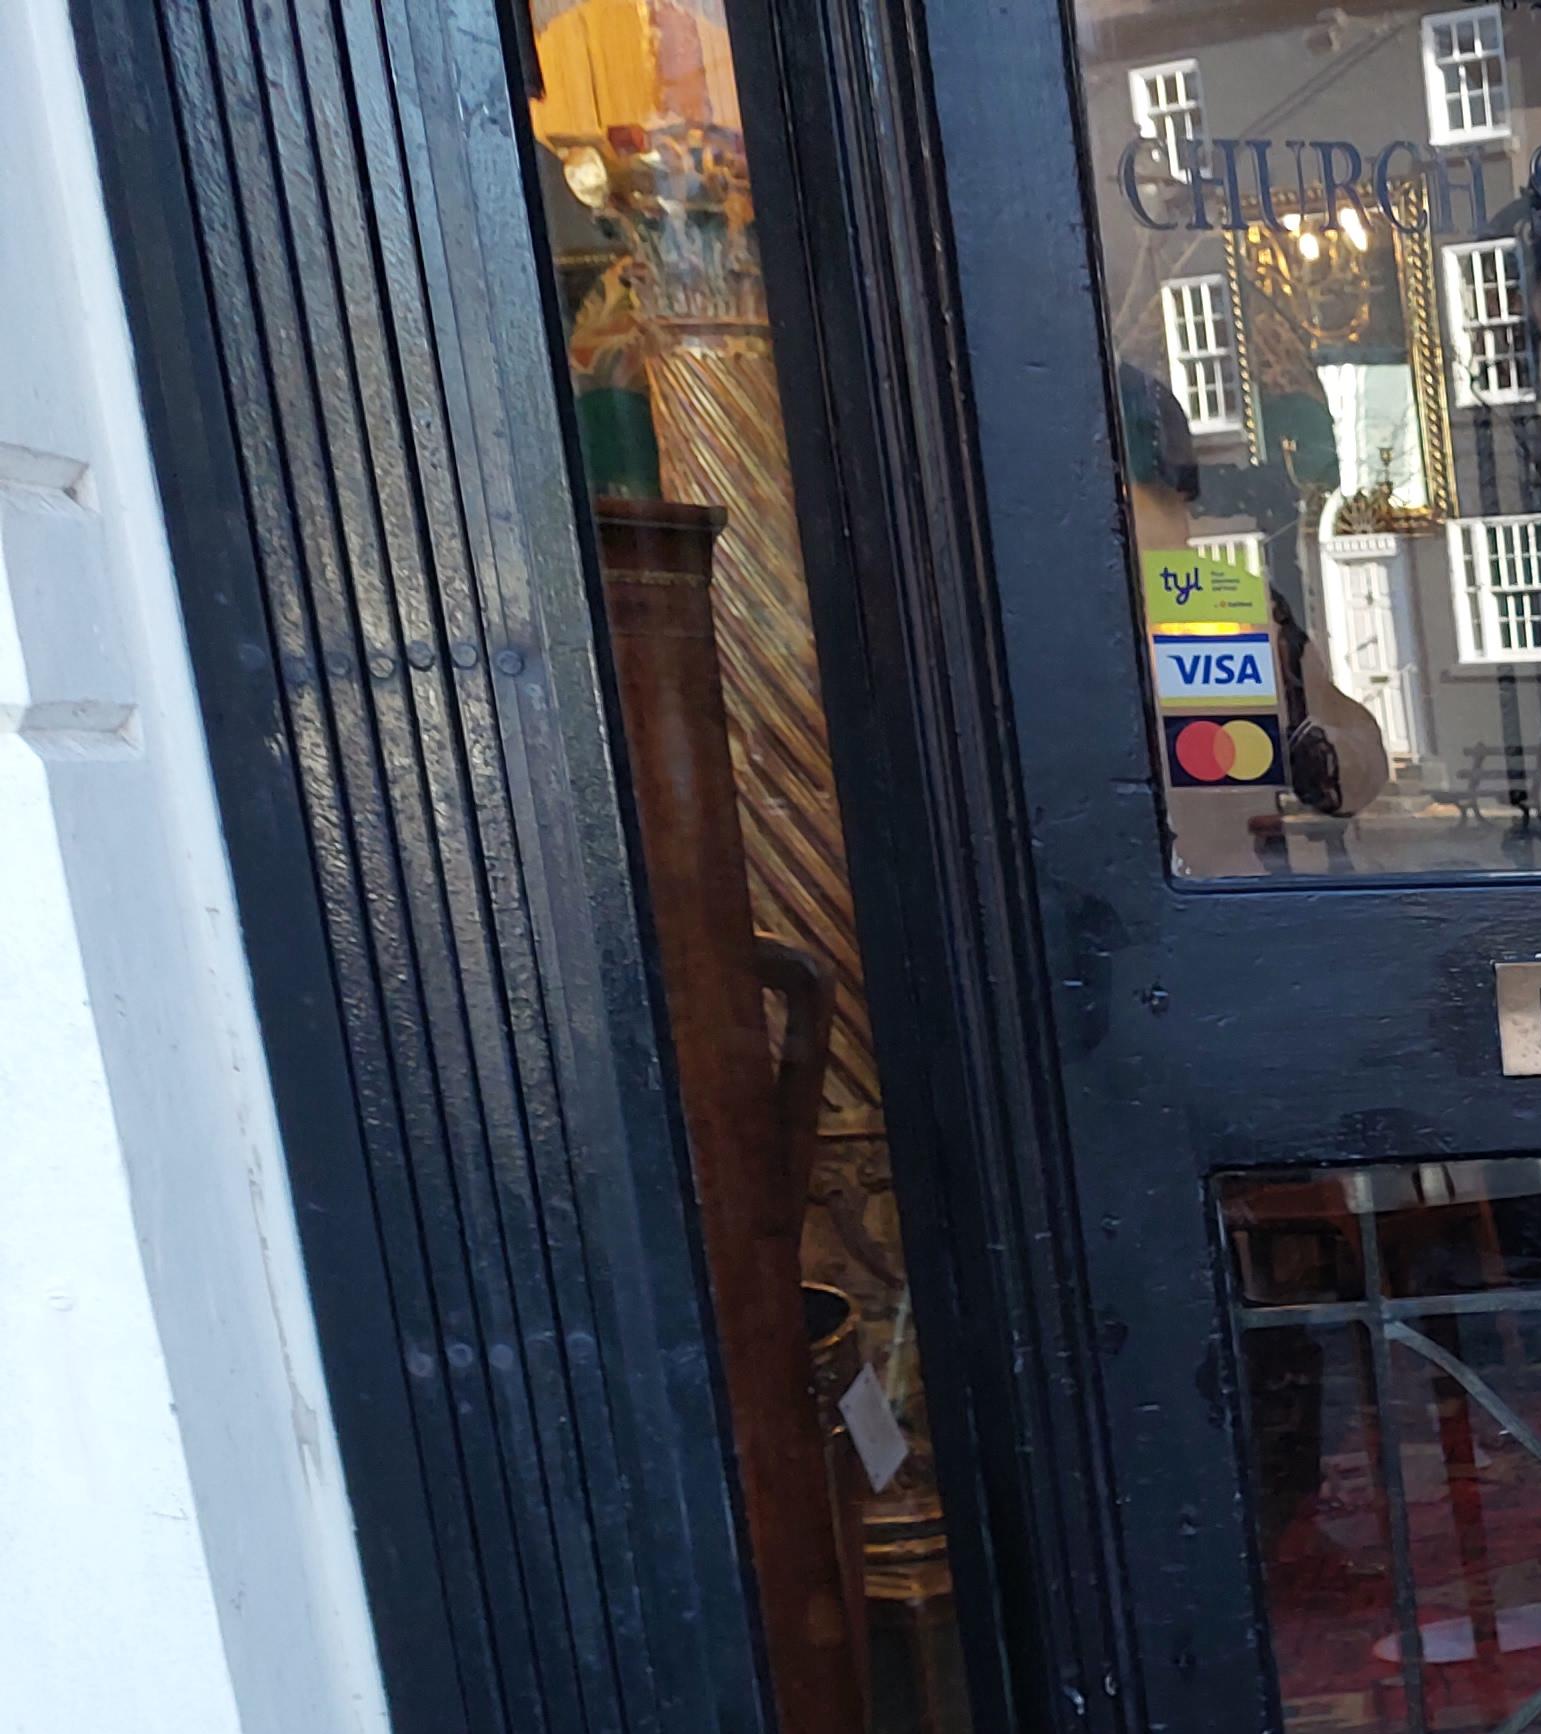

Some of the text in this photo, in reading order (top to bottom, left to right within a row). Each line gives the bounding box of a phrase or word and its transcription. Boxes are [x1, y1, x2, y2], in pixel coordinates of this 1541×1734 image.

[1118, 138, 1489, 235] CHURCH
[1160, 566, 1204, 606] tyl
[1167, 653, 1263, 686] VISA
